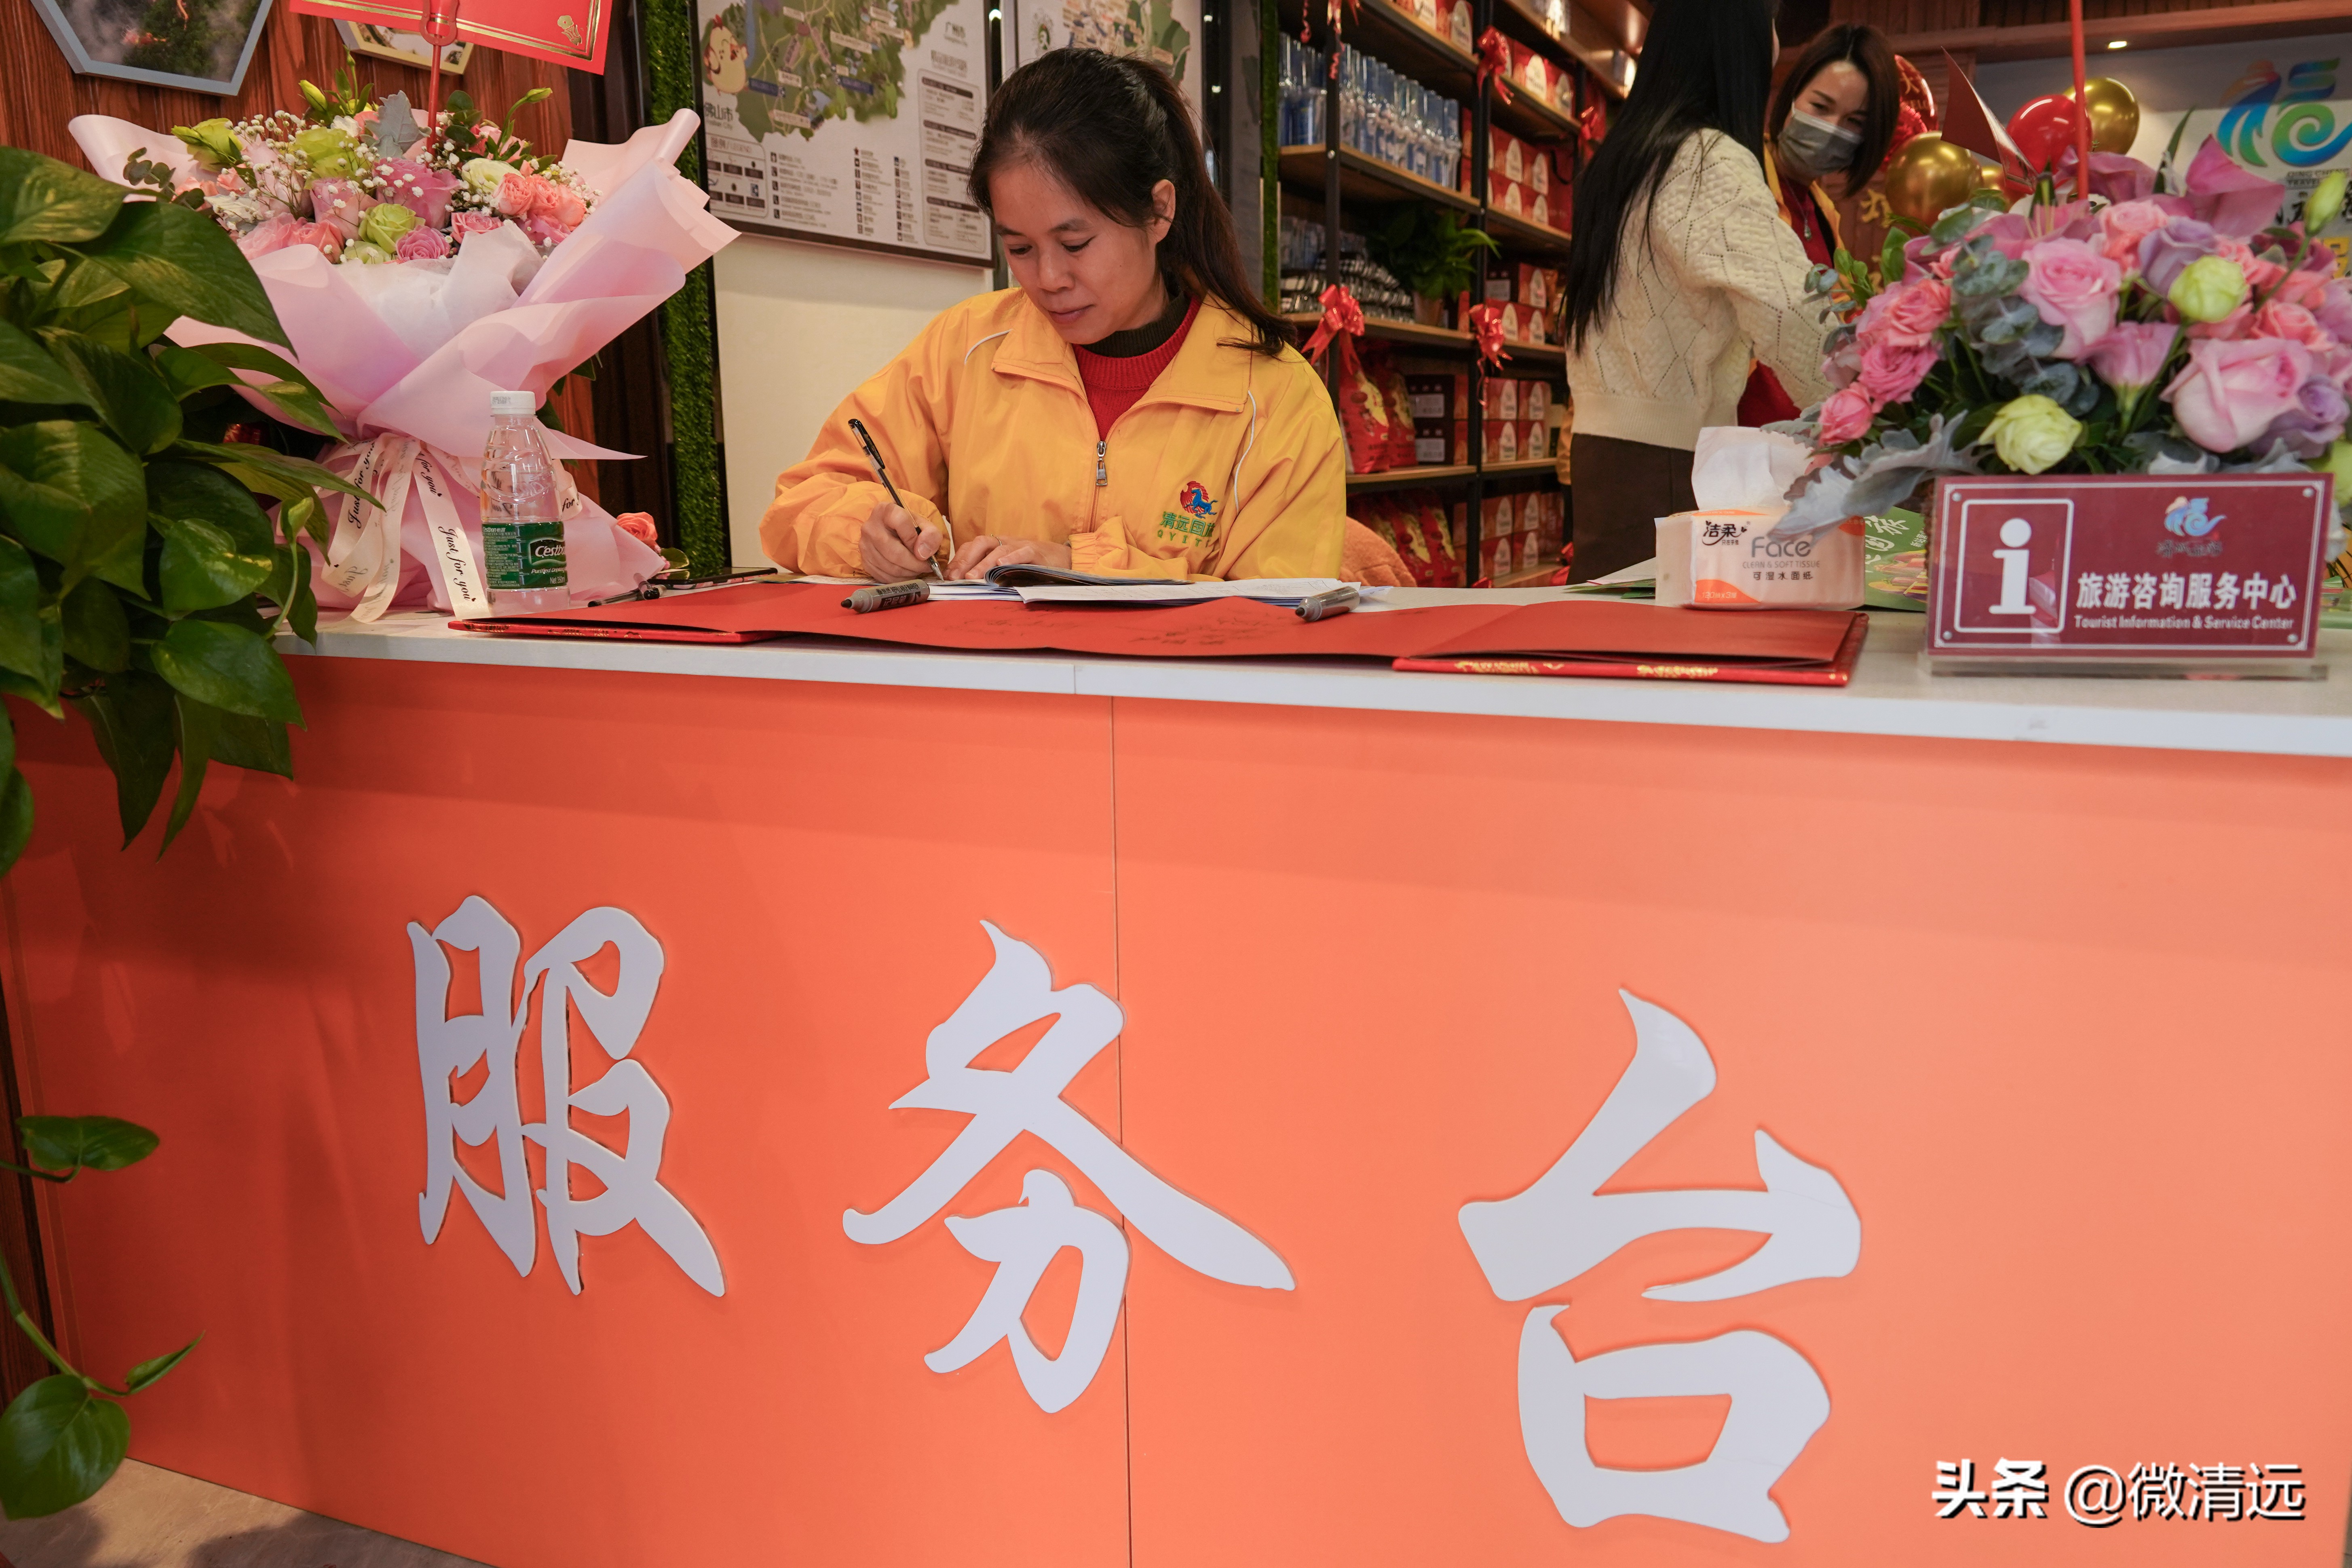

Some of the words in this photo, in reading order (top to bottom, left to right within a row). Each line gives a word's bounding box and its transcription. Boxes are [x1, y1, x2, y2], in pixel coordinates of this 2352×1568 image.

[363, 442, 376, 470] you
[416, 457, 432, 473] for
[421, 471, 438, 496] you
[562, 498, 575, 513] for
[438, 526, 458, 553] Just
[1702, 522, 1741, 539] 洁柔
[1751, 536, 1811, 558] Face
[446, 551, 467, 576] for
[1753, 571, 1814, 580] 可湿水面纸
[453, 577, 472, 601] you
[2075, 572, 2297, 610] 旅游咨询服务中心
[2074, 615, 2117, 629] Tourist
[2119, 615, 2191, 629] Information
[2192, 615, 2202, 629] &
[2204, 616, 2251, 629] Service
[2252, 616, 2294, 629] Center
[407, 895, 1862, 1543] 服务台
